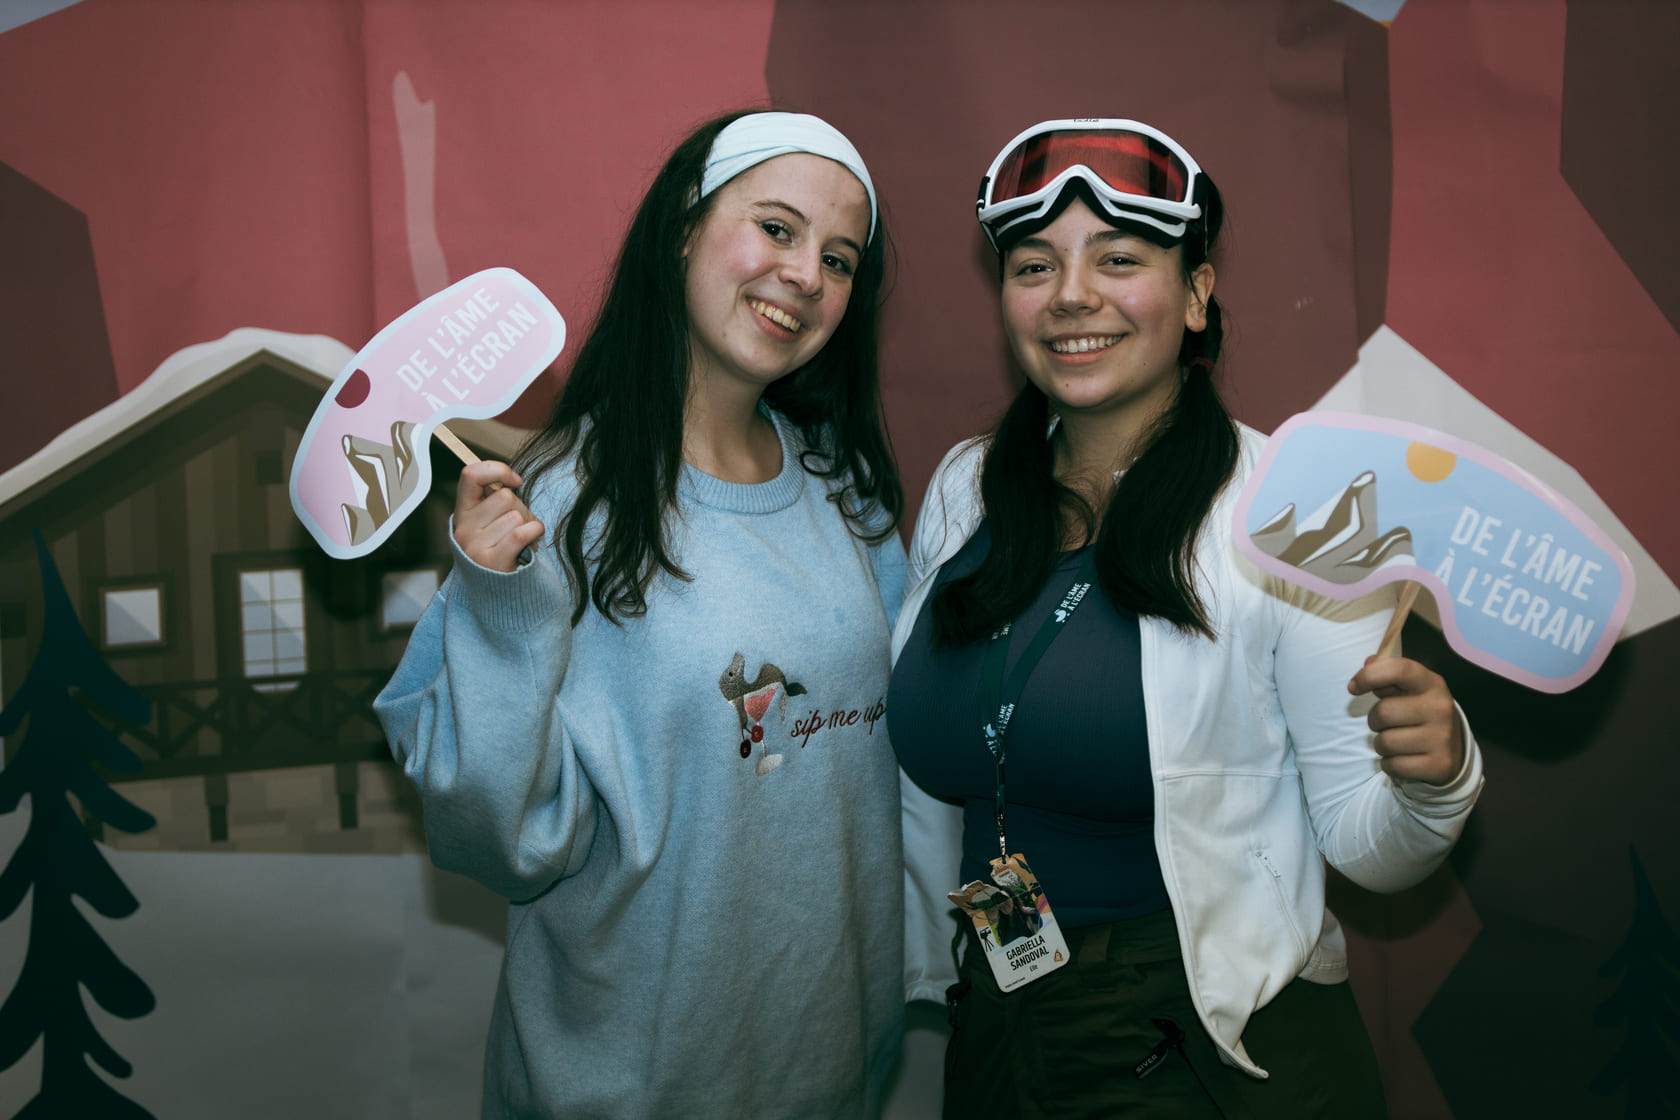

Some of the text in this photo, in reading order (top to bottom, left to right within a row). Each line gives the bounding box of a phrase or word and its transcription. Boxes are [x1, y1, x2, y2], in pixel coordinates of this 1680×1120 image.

[396, 287, 500, 392] DE L'ÂME
[420, 302, 538, 412] À L'ÉCRAN
[1451, 506, 1602, 600] DE L'ÂME
[1435, 547, 1595, 655] À L'ÉCRAN
[791, 697, 888, 749] sip me up
[1006, 935, 1046, 961] GABRIELLA
[1010, 945, 1050, 971] SANDOVAL
